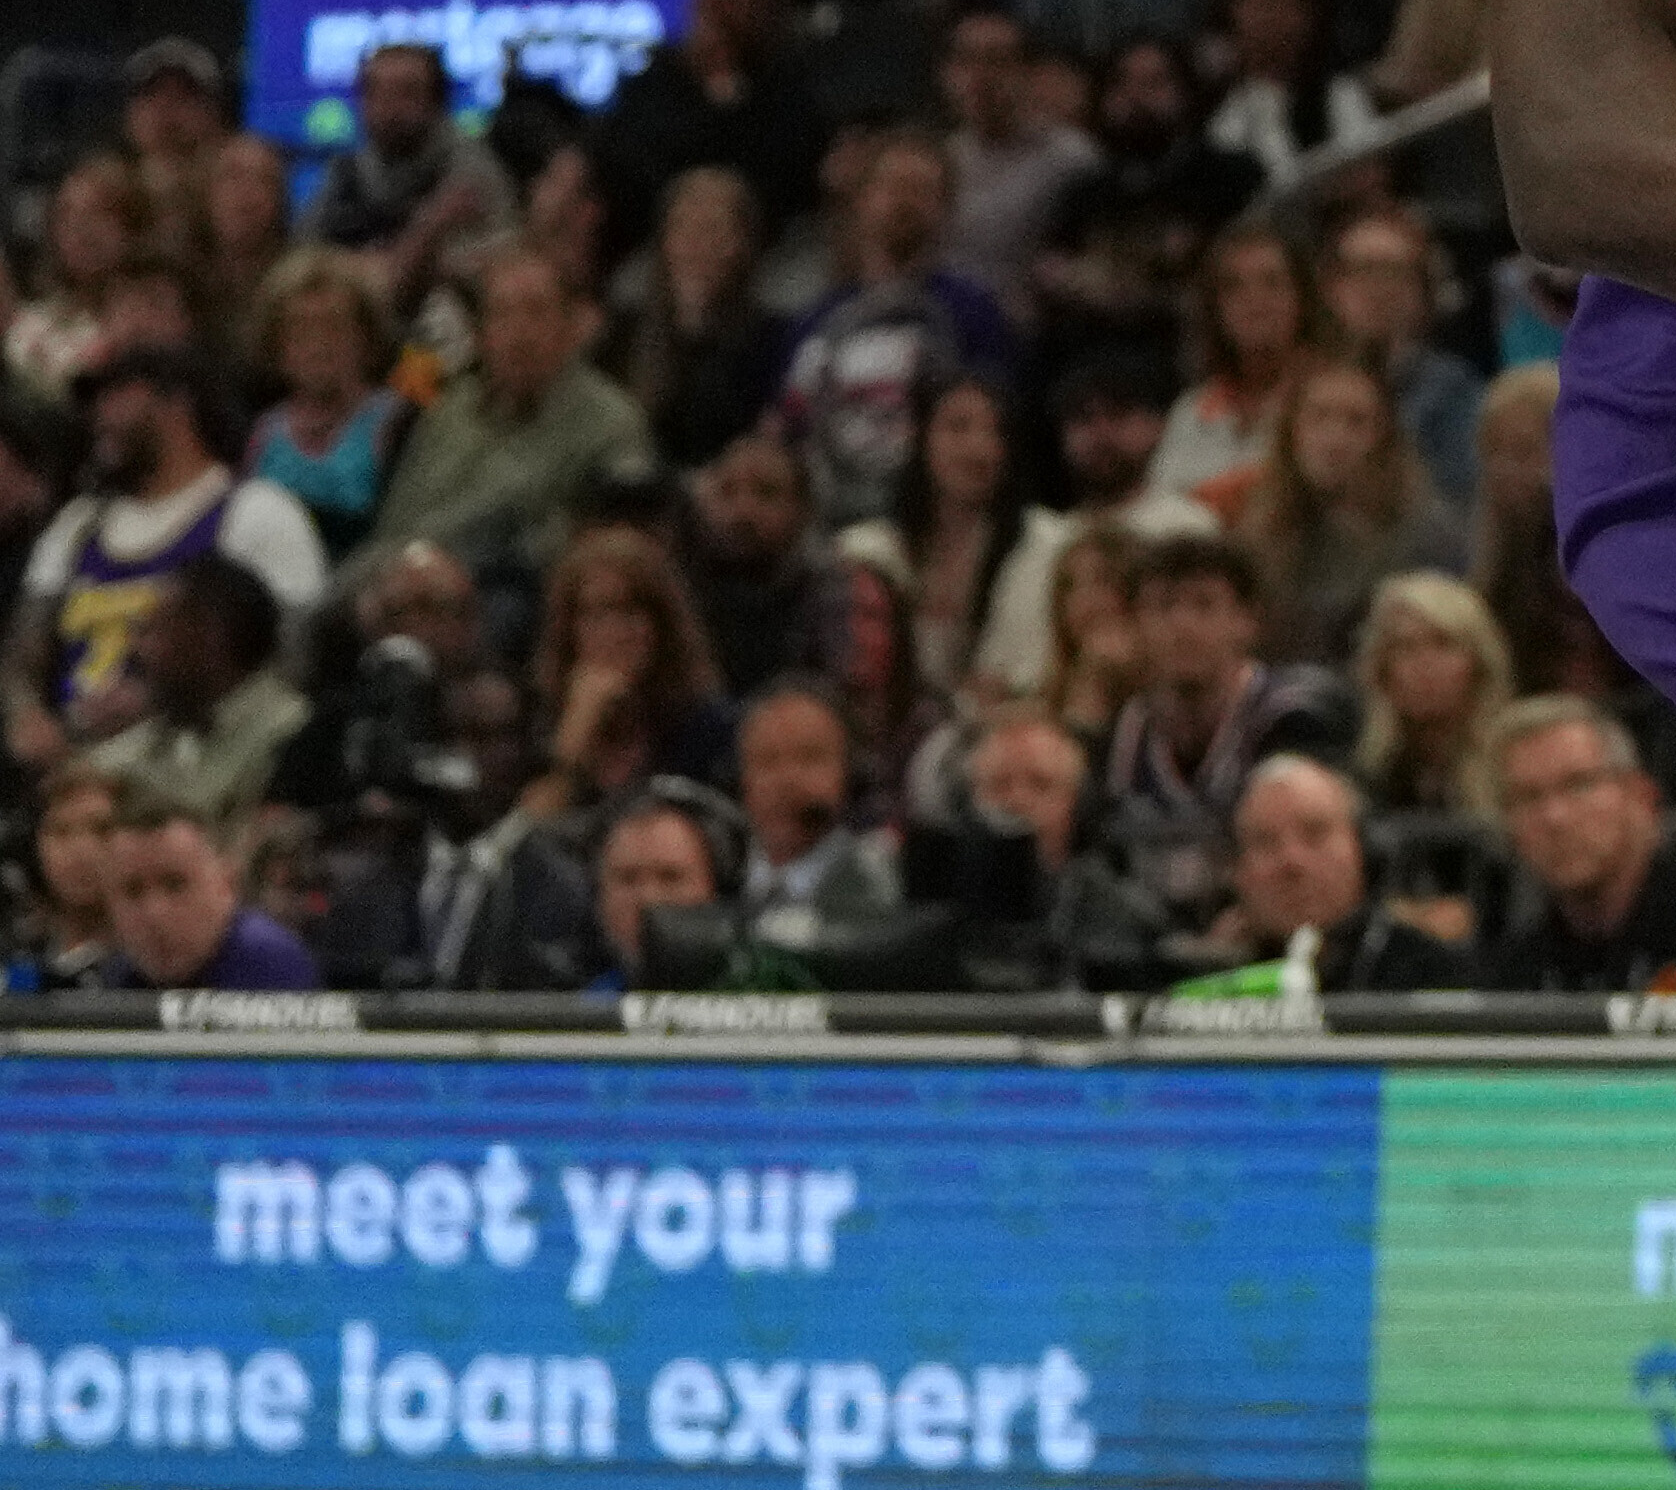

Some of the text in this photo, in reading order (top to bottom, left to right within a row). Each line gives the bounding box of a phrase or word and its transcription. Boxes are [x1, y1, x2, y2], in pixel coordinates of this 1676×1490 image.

[213, 1143, 857, 1304] meet your
[0, 1311, 1097, 1490] home loan expert
